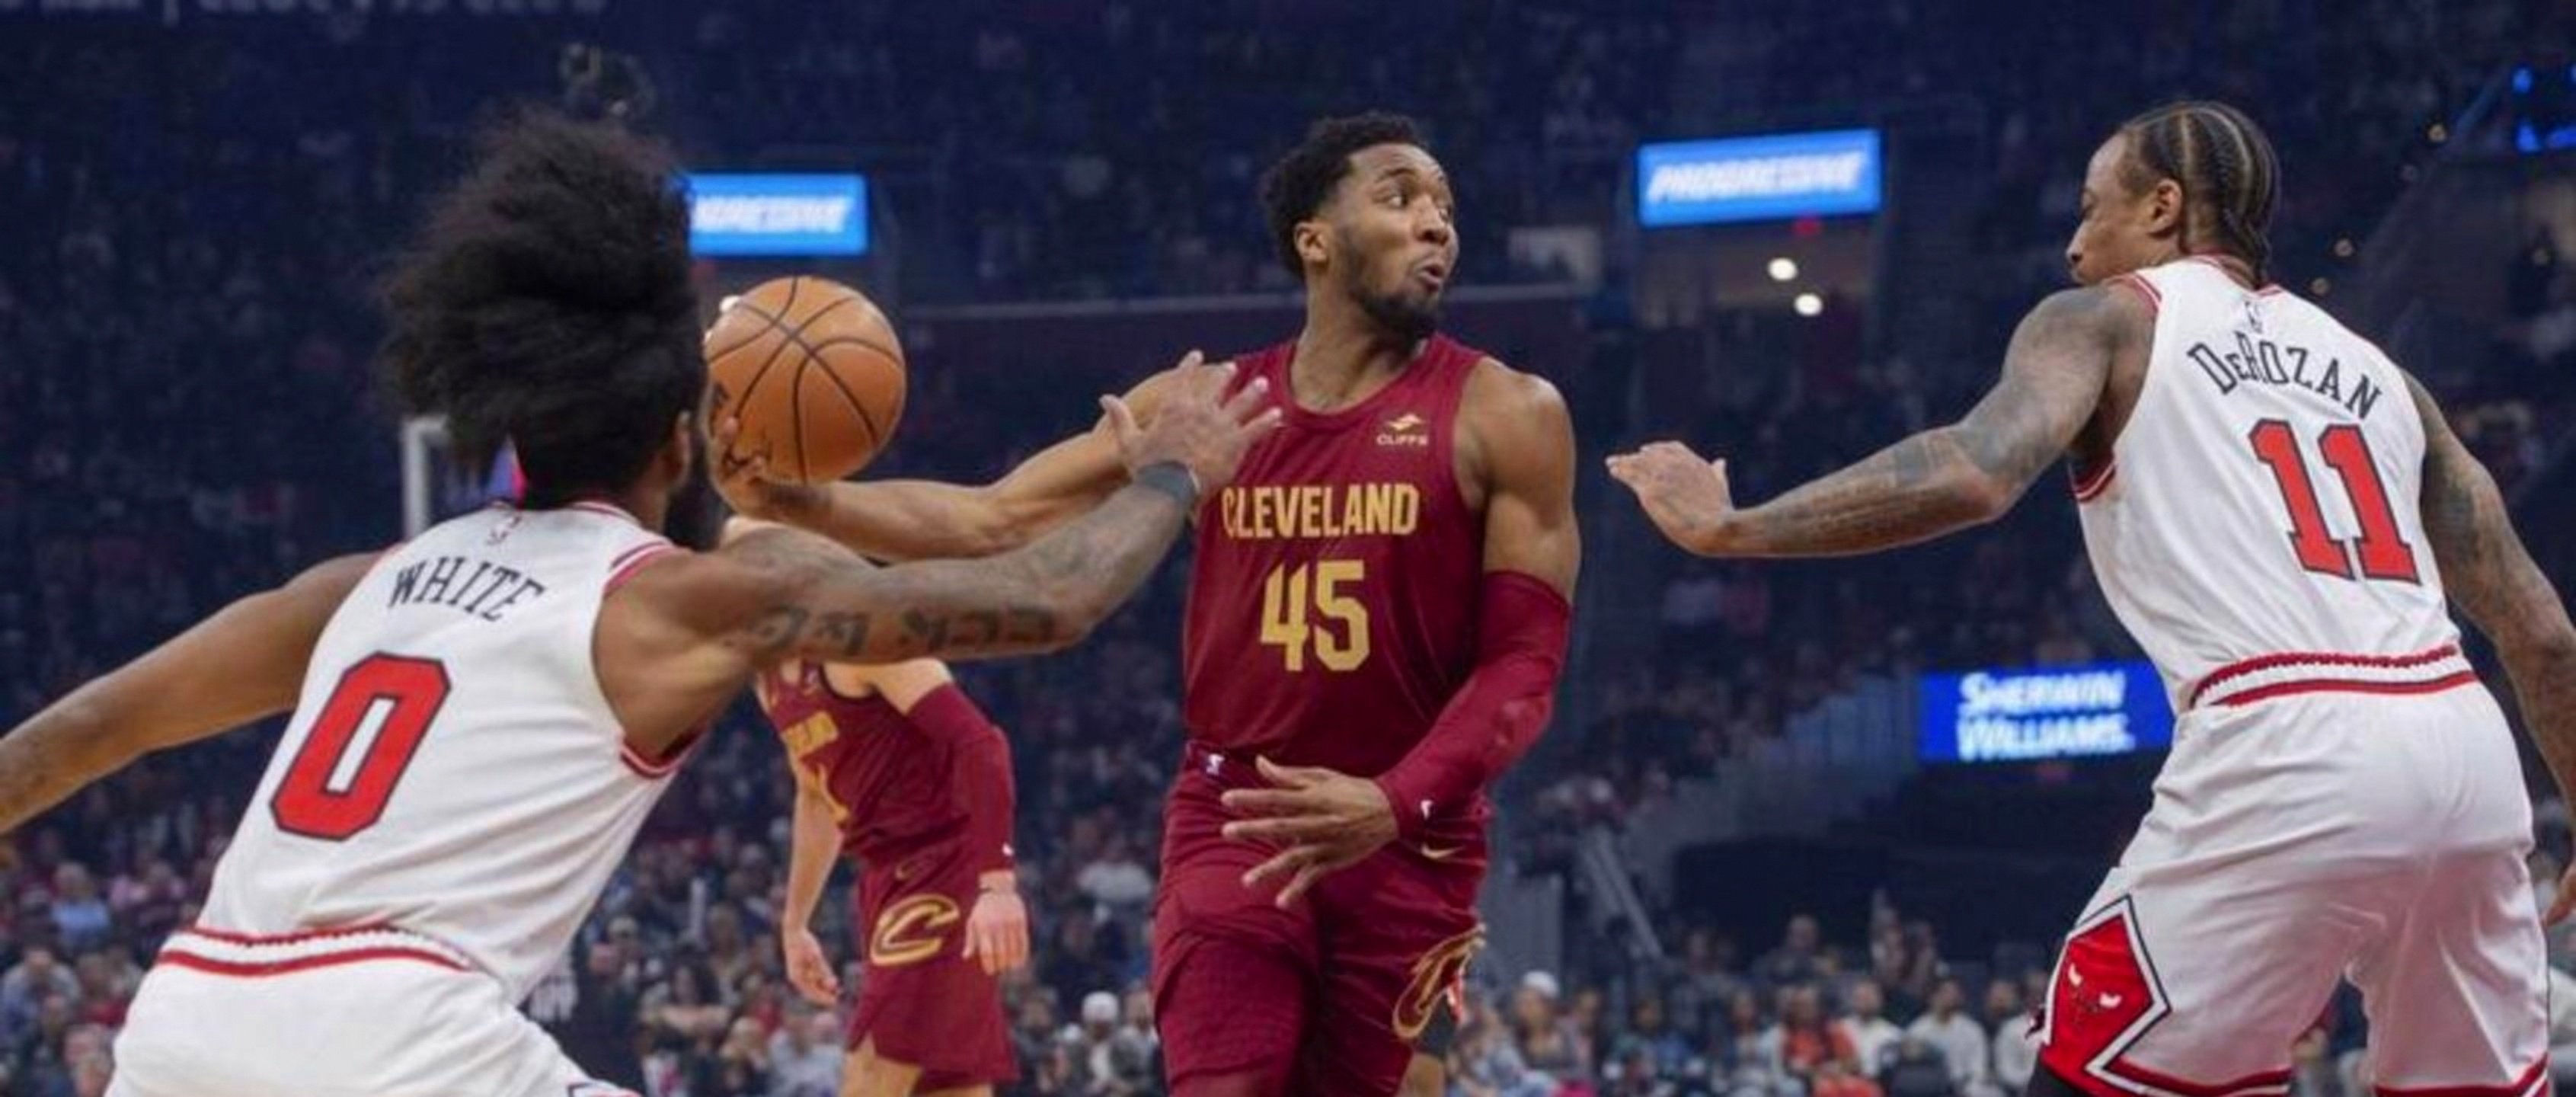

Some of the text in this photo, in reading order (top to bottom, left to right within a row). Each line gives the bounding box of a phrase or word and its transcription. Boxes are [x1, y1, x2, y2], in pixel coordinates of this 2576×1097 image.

[1377, 433, 1429, 446] CLIFFS
[1222, 484, 1419, 539] CLEVELAND
[2248, 418, 2421, 585] 11
[388, 556, 545, 623] WHITE
[1261, 559, 1369, 671] 45
[269, 651, 452, 841] 0
